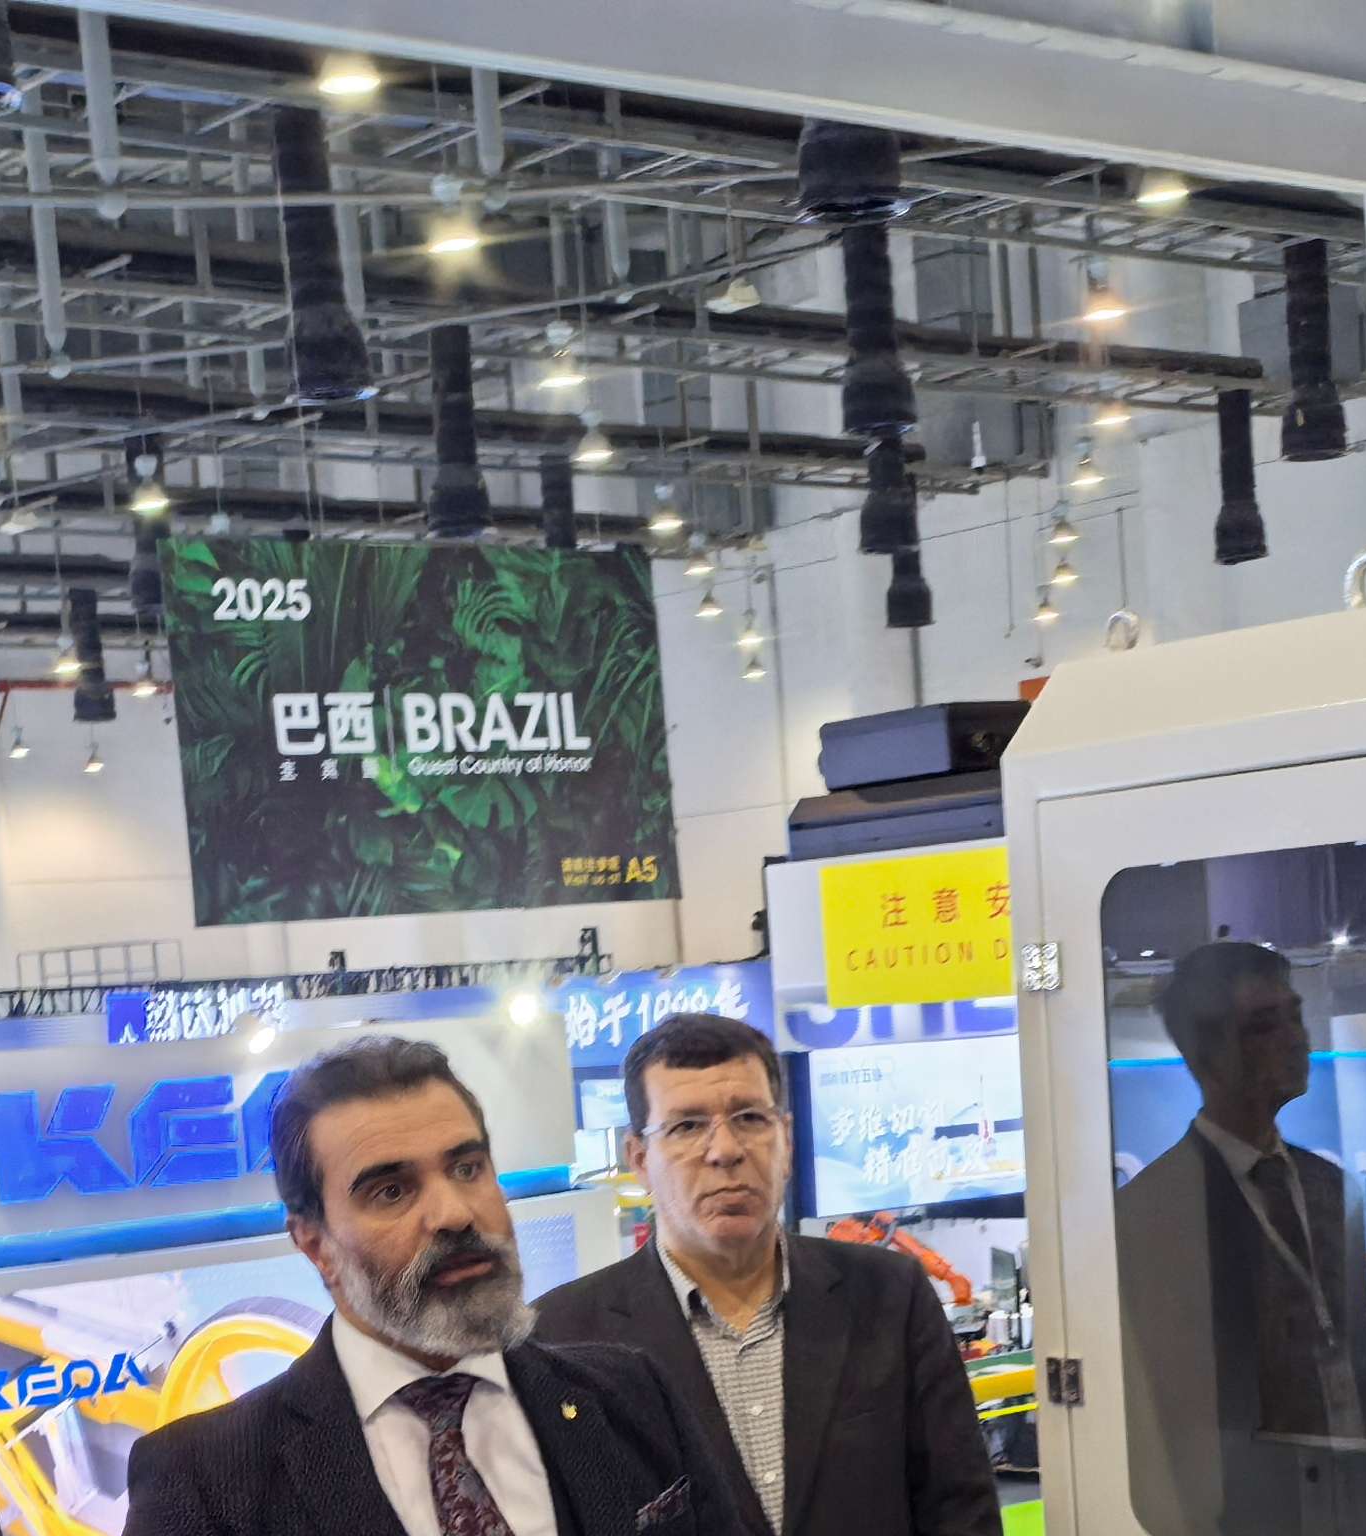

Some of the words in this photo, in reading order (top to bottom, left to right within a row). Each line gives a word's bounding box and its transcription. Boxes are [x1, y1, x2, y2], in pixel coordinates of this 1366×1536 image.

[212, 578, 312, 621] 2025
[273, 691, 377, 756] 巴西
[403, 691, 592, 752] BRAZIL
[624, 855, 659, 883] A5
[846, 942, 973, 972] CAUTION
